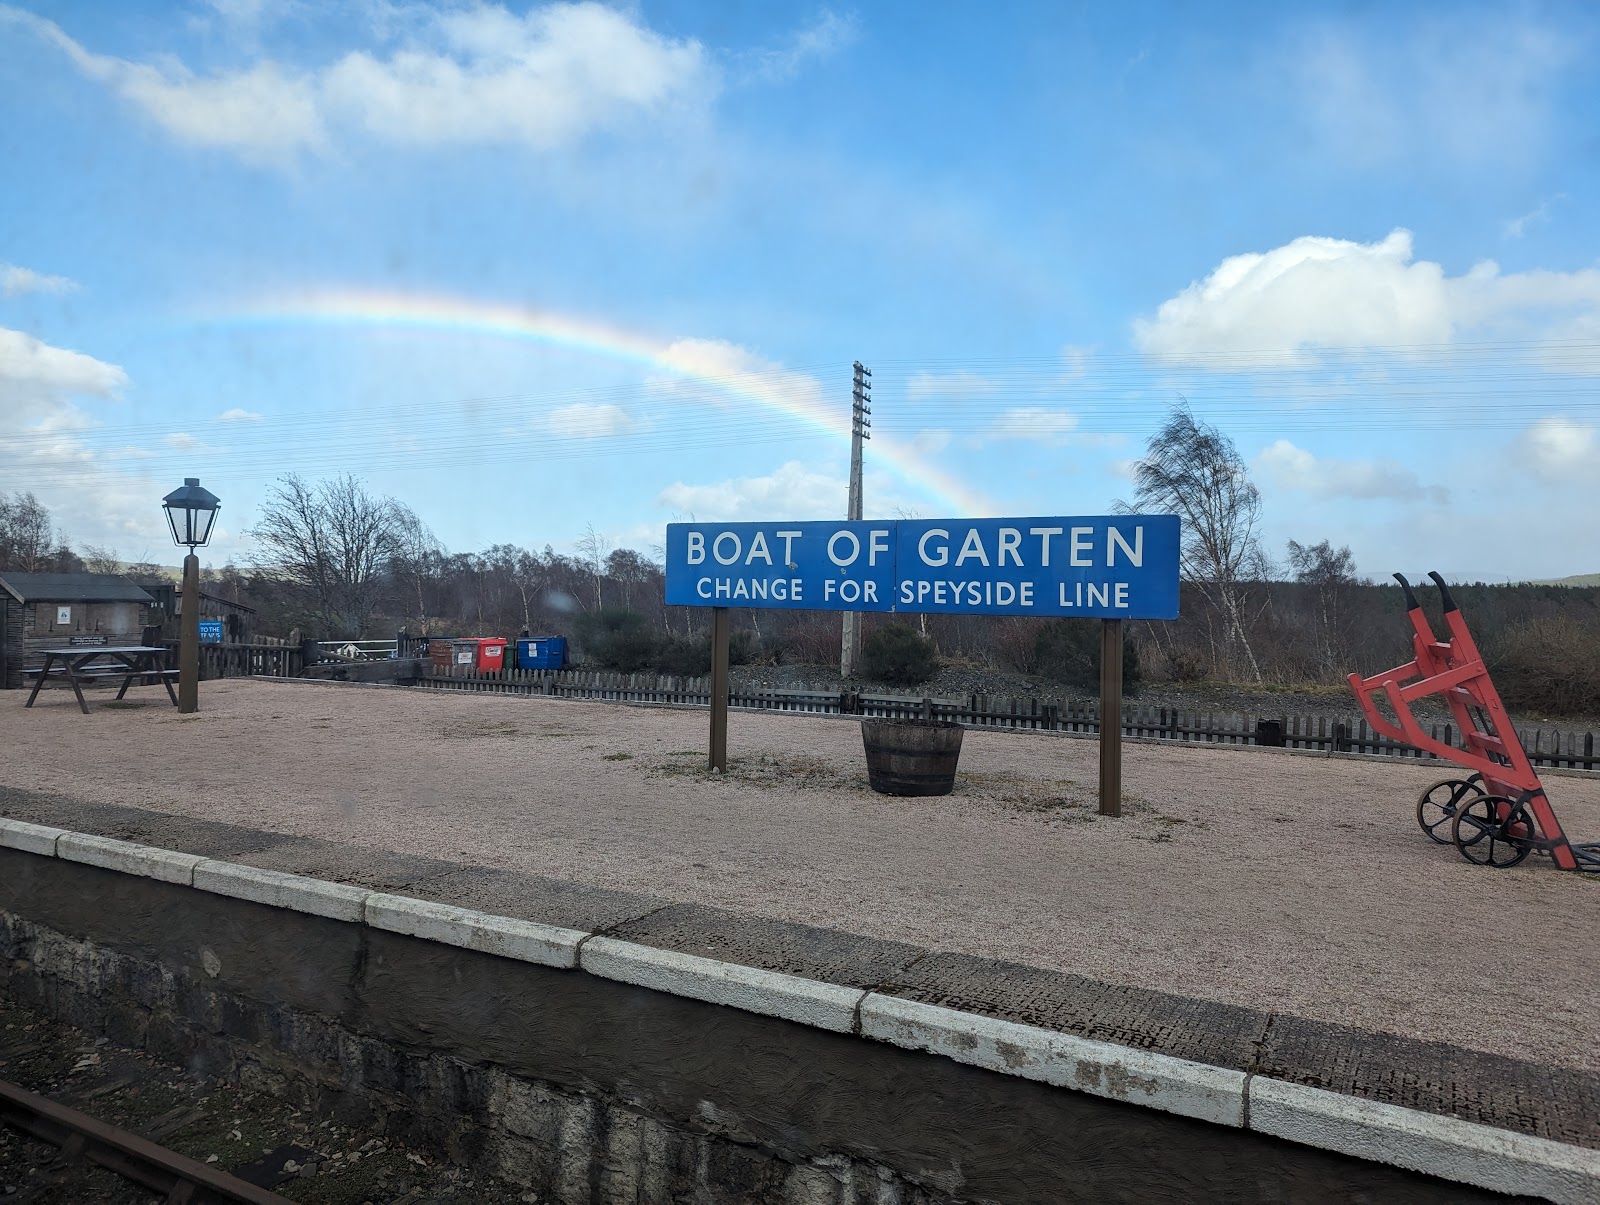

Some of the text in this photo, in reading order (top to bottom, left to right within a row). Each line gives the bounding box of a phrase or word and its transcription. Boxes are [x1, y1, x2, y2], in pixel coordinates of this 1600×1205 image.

[687, 526, 1143, 567] BOAT OF GARTEN
[696, 577, 1129, 608] CHANGE FOR SPEYSIDE LINE
